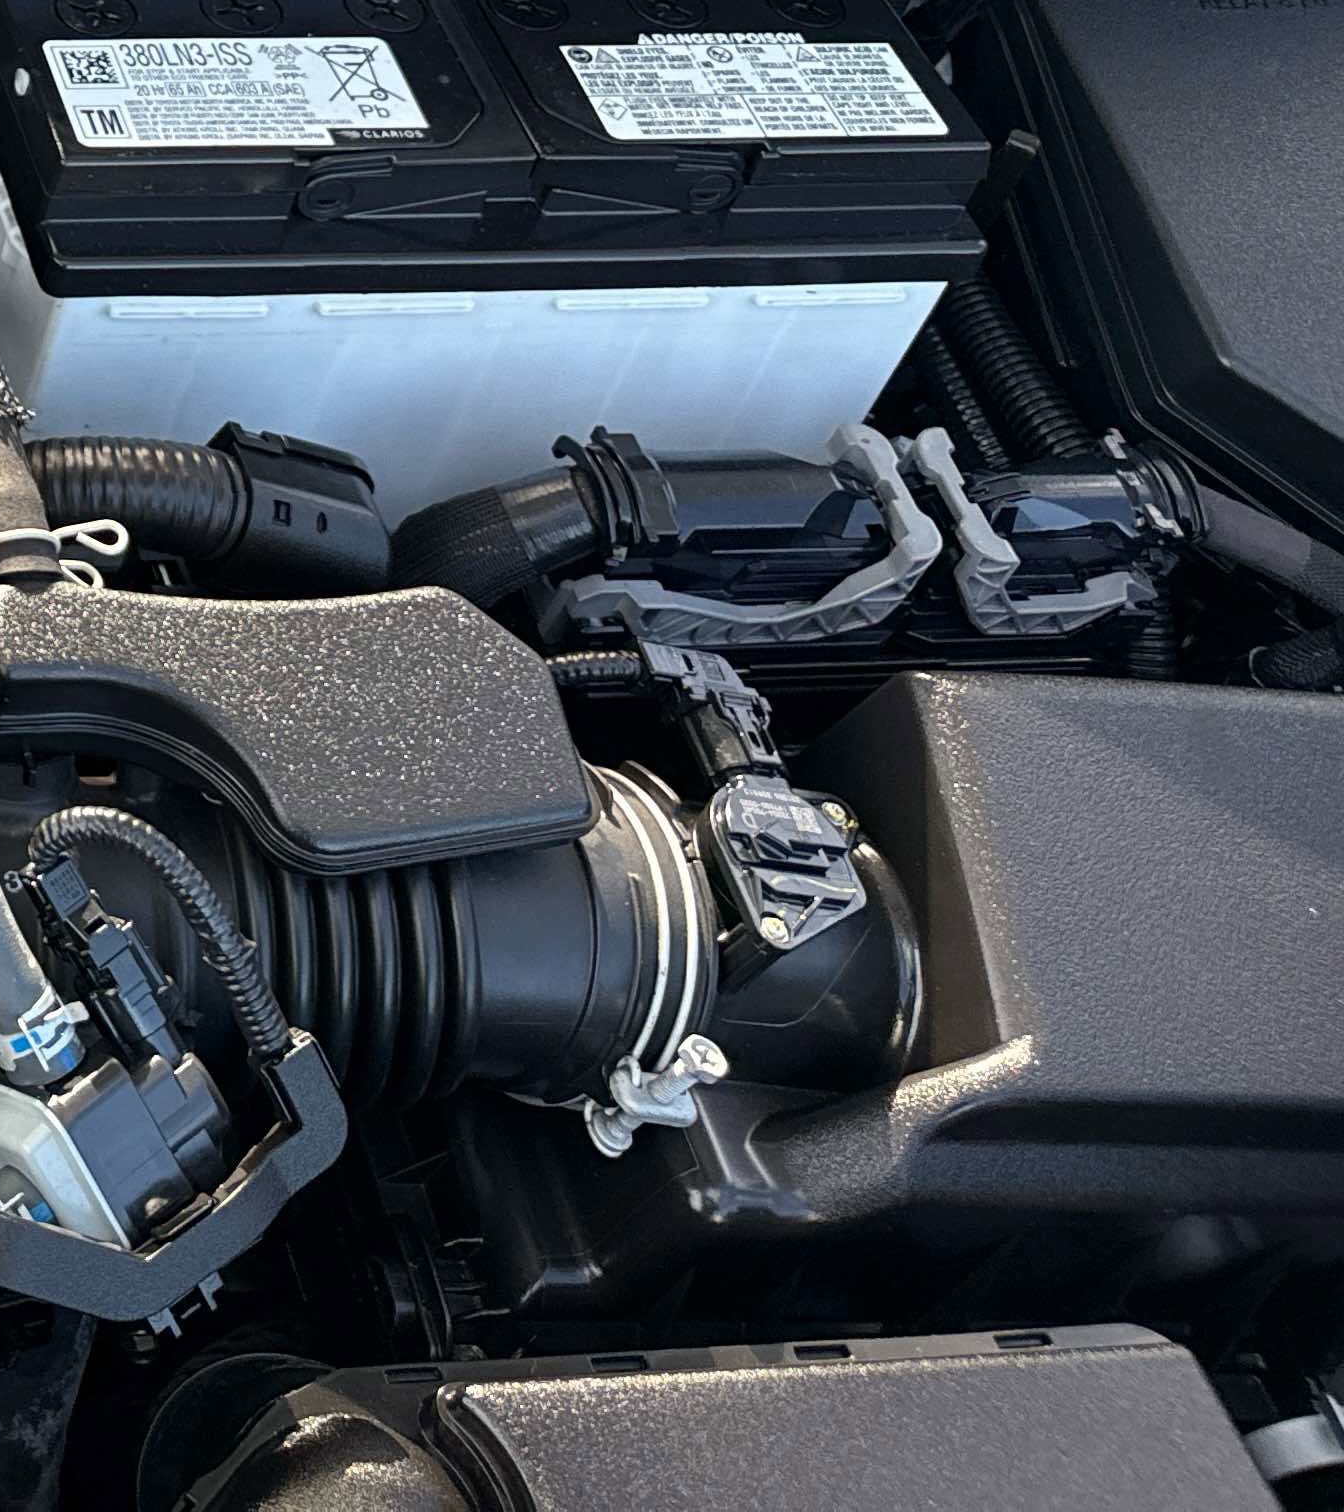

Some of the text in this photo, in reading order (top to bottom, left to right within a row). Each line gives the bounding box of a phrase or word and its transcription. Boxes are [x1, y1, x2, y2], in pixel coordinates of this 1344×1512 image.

[651, 32, 805, 45] DANGER/POISON
[119, 42, 252, 66] 380LN3-ISS
[134, 84, 150, 96] 20
[151, 84, 166, 96] Hr
[166, 83, 185, 96] 65
[186, 83, 203, 96] Ah
[207, 83, 234, 95] CCA
[271, 82, 306, 95] (SAE)
[355, 103, 393, 119] Pb
[80, 109, 124, 136] TM
[362, 129, 425, 140] CLARIOS
